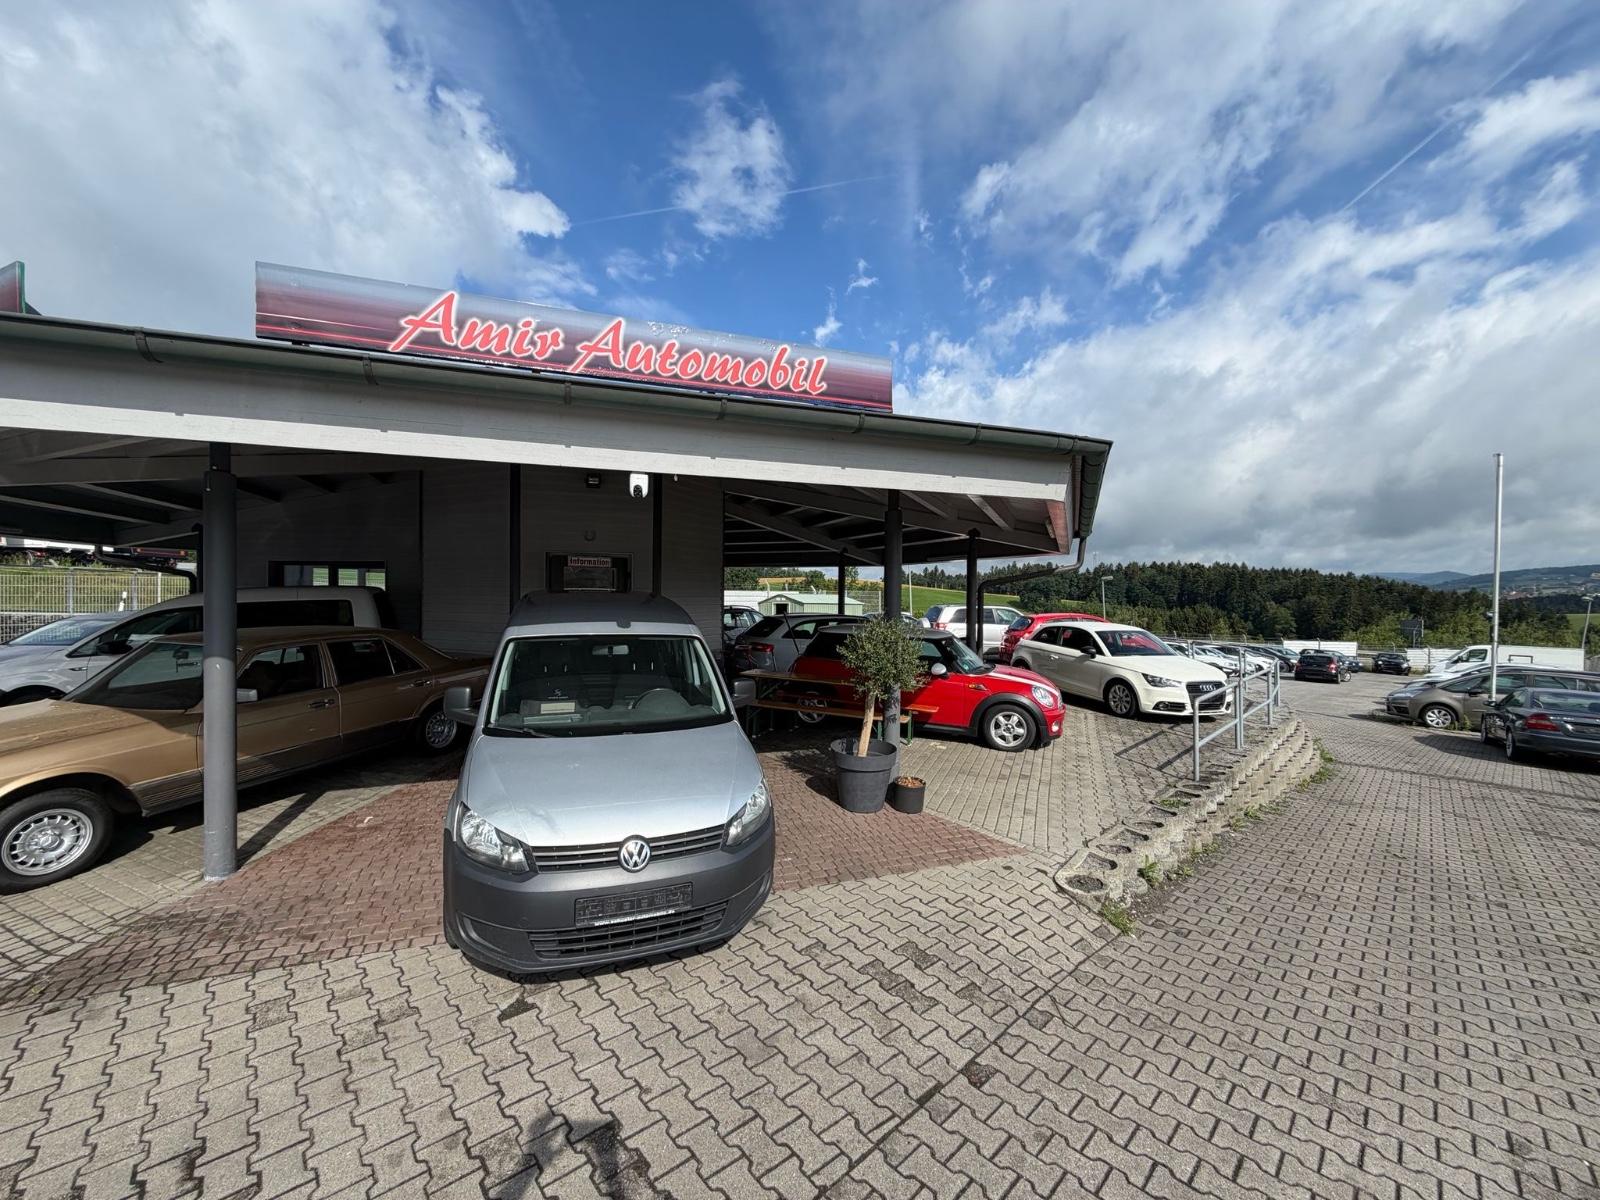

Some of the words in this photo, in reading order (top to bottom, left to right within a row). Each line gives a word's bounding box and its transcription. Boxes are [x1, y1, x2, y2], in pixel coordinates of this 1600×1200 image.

[389, 289, 565, 361] Amir
[567, 317, 828, 395] Automobil
[569, 557, 610, 566] Information
